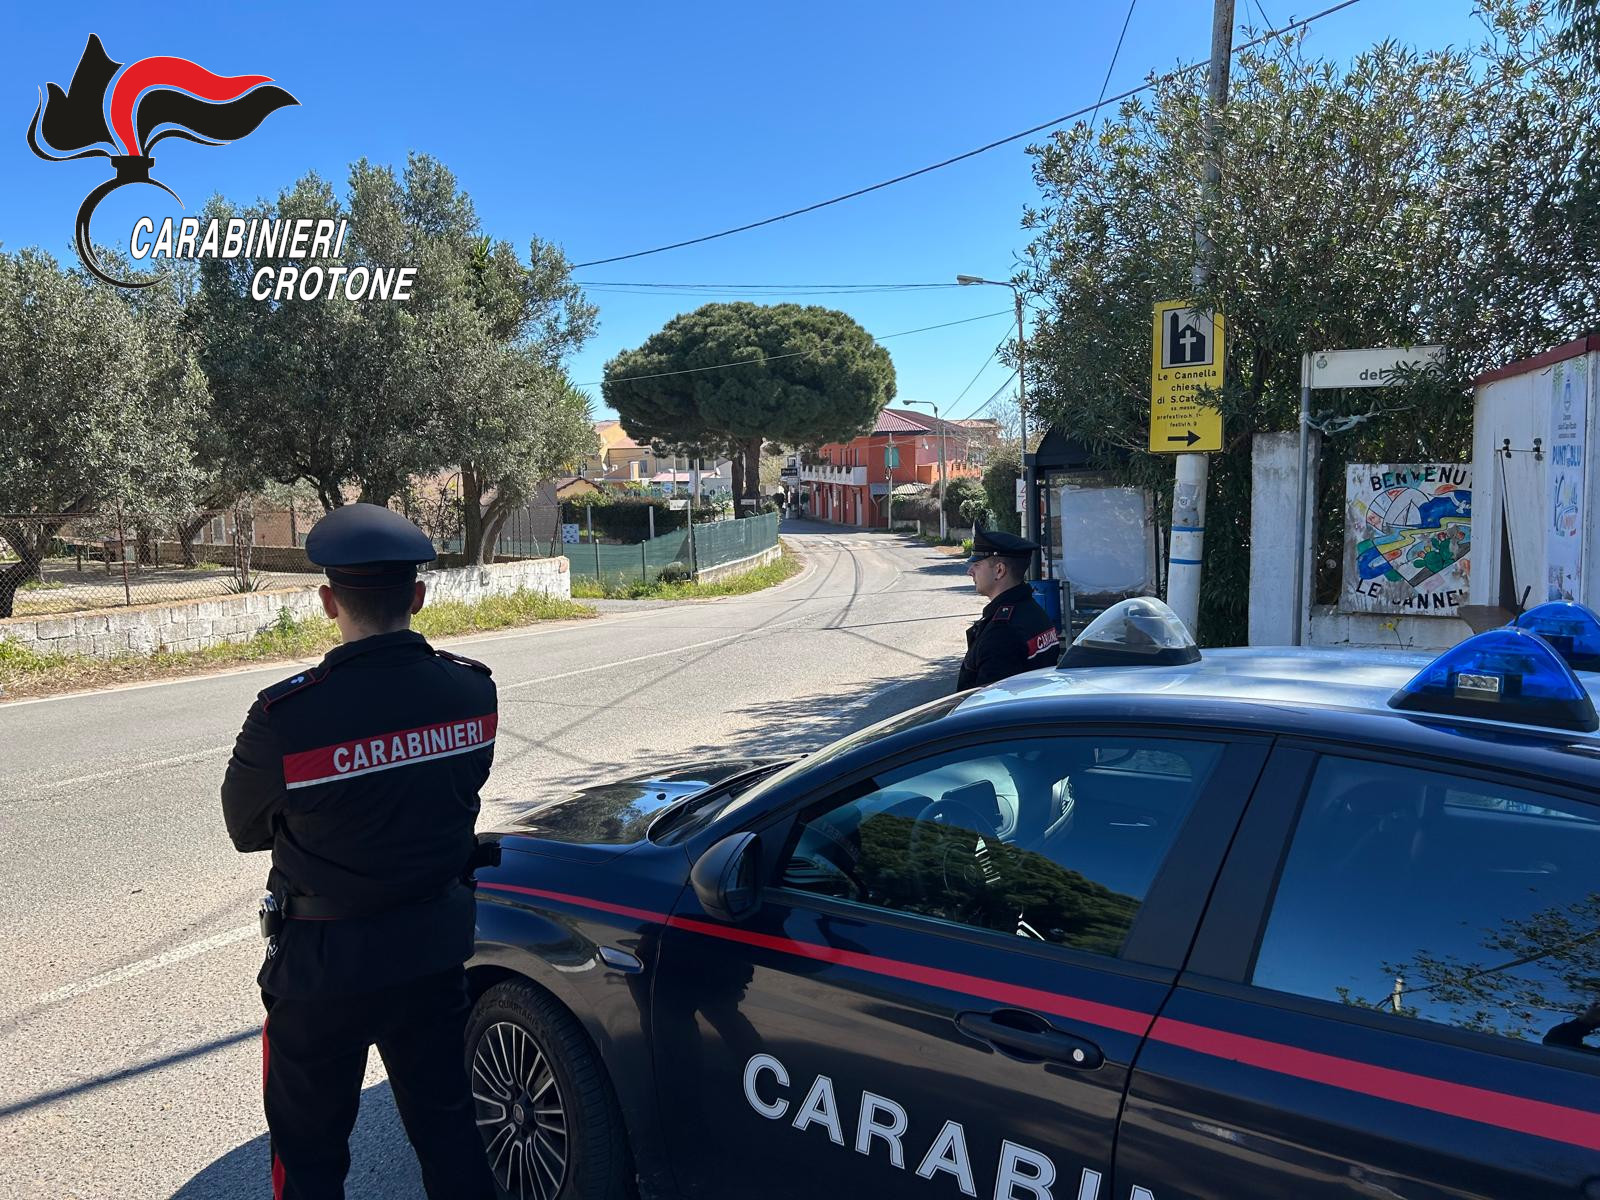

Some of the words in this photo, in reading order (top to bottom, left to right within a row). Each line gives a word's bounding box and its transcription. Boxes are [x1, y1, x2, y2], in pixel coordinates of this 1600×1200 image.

[1157, 373, 1168, 381] Le
[1174, 369, 1217, 380] Cannella
[1157, 397, 1165, 405] di
[1370, 466, 1472, 491] BENVENU
[1355, 578, 1382, 599] LE
[333, 720, 484, 773] CARABINIERI
[743, 1053, 1154, 1200] CARABI
